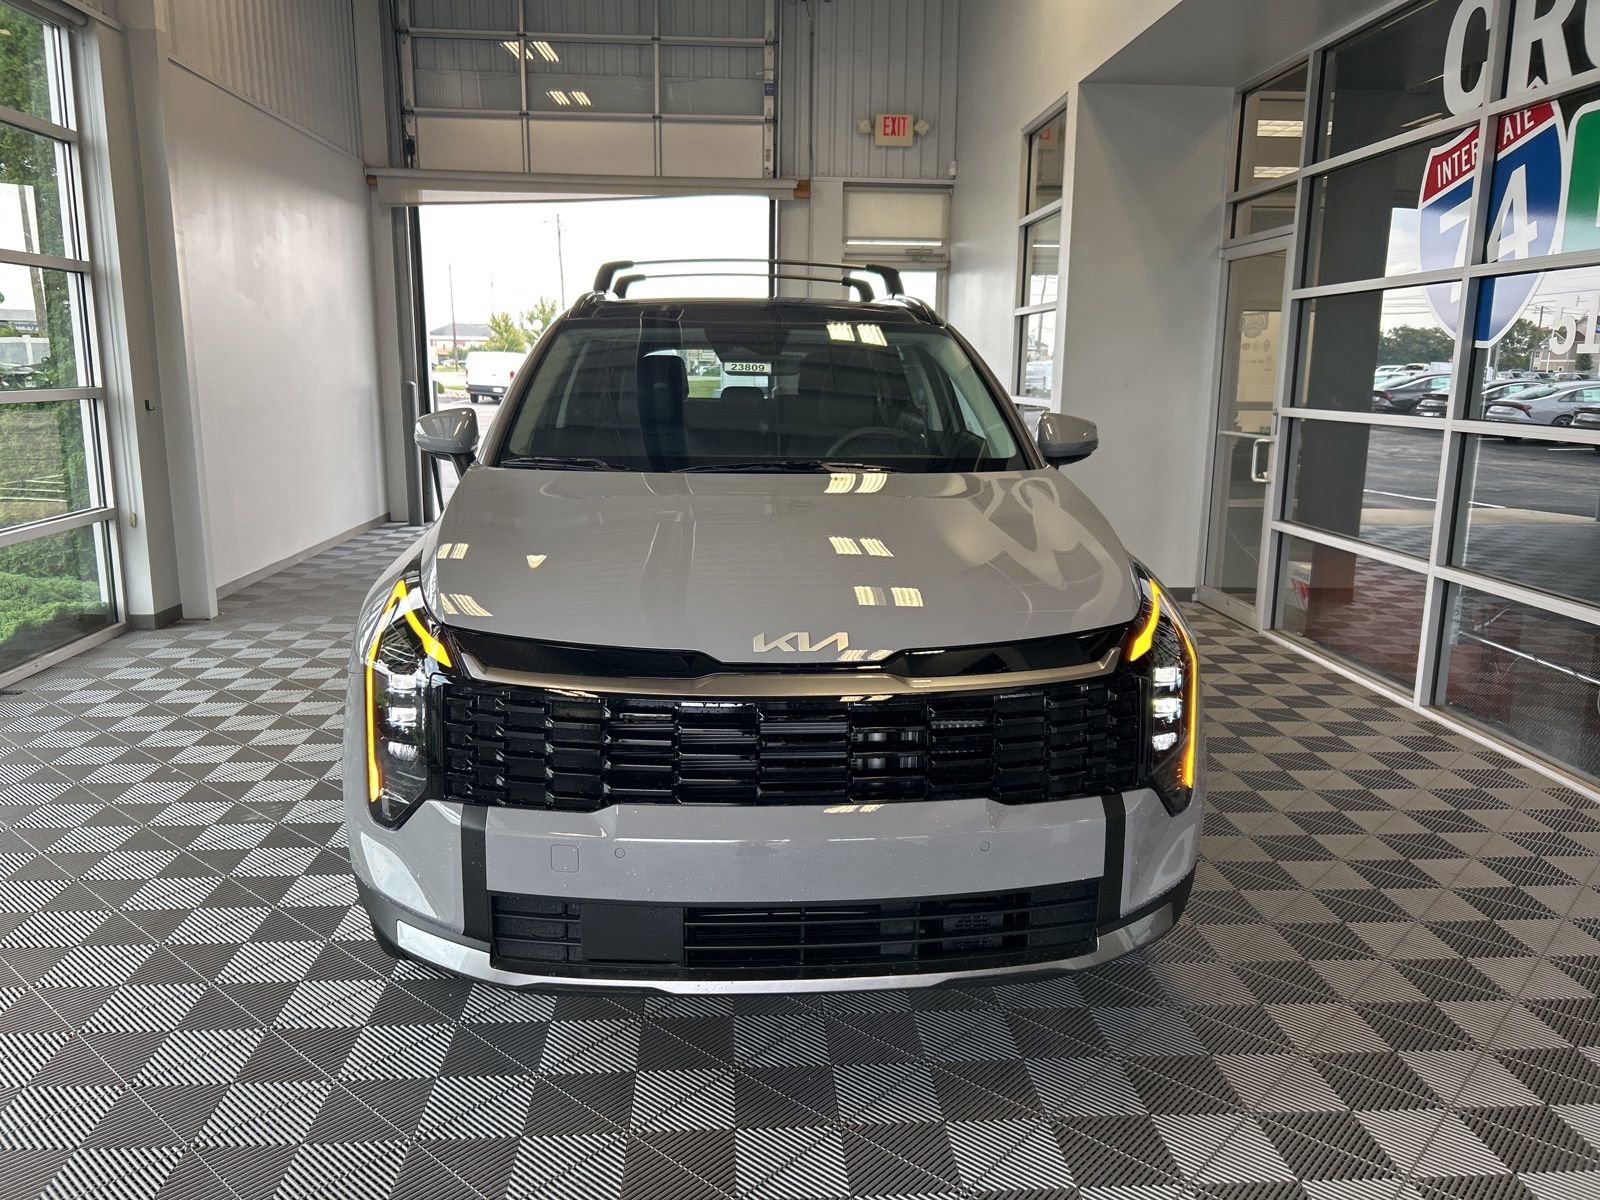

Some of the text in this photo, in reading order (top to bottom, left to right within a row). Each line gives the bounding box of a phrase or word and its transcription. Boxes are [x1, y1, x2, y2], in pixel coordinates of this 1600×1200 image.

[1443, 0, 1600, 116] CR
[882, 115, 908, 137] EXIT
[1437, 108, 1535, 188] INTERATE
[1440, 164, 1538, 304] 74
[731, 363, 765, 372] 23809
[753, 631, 849, 652] KIA
